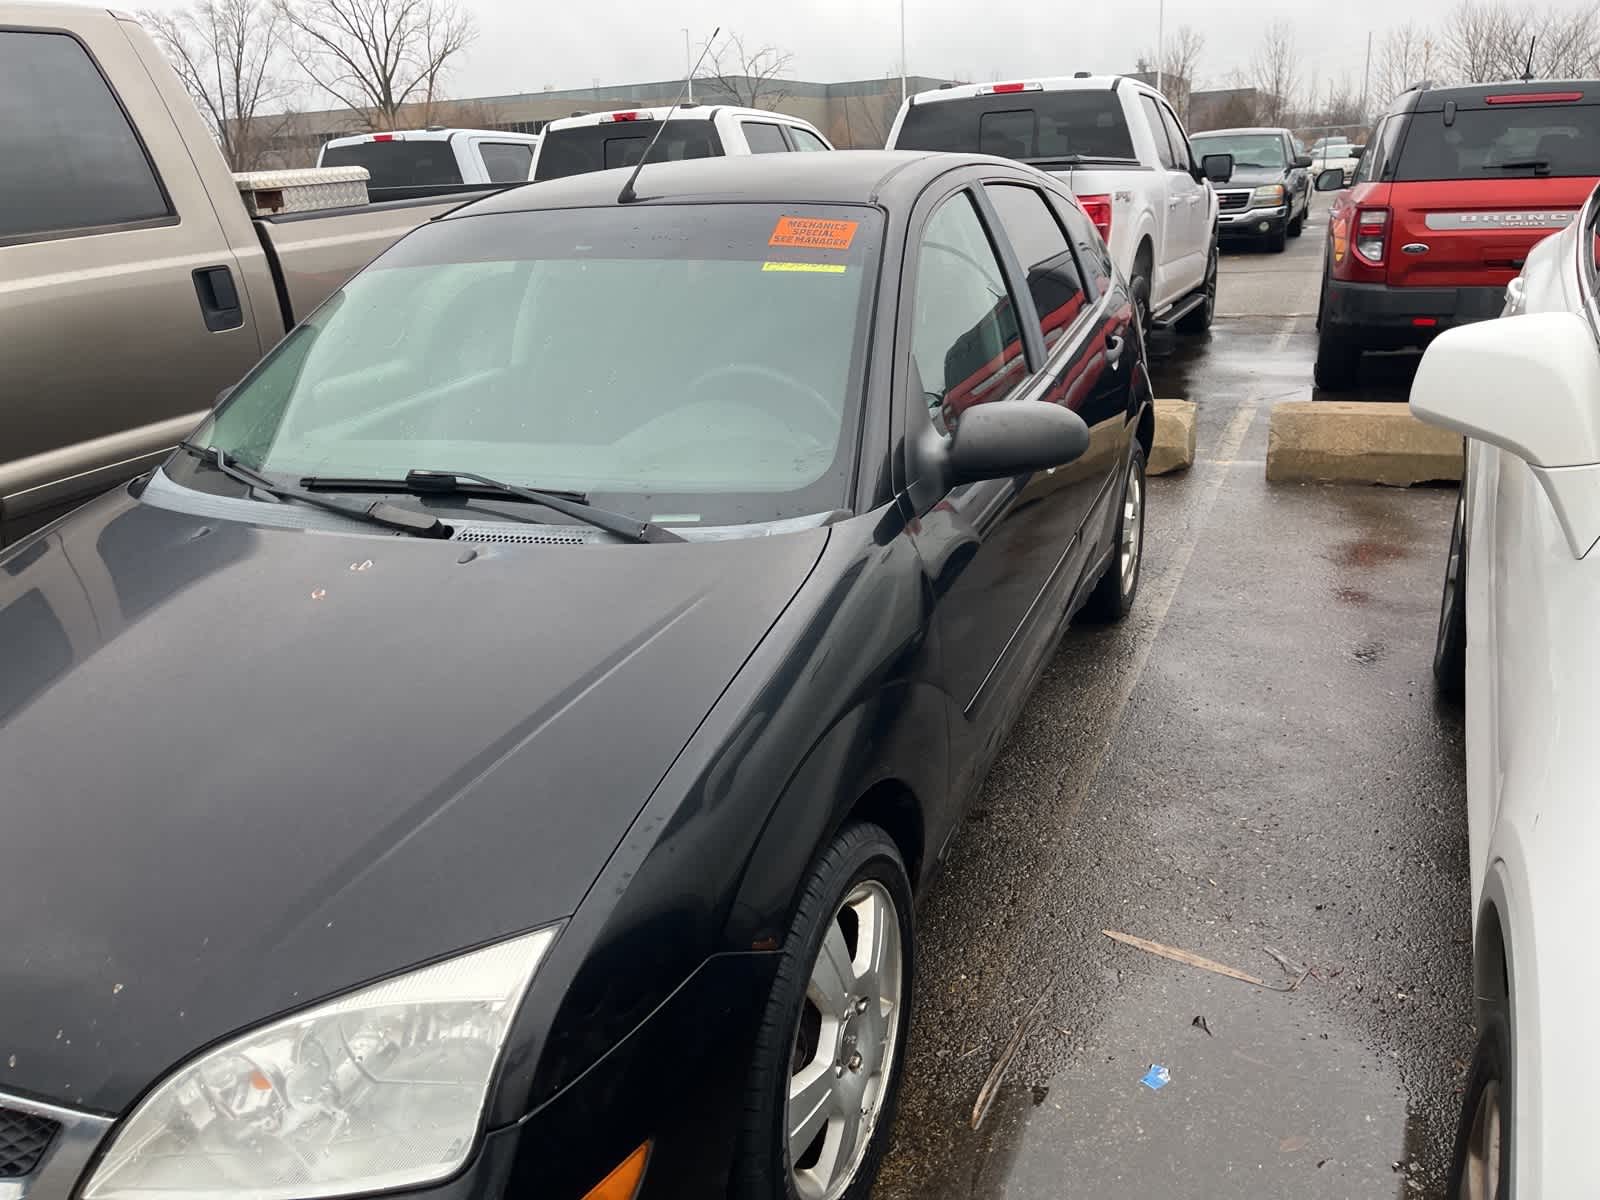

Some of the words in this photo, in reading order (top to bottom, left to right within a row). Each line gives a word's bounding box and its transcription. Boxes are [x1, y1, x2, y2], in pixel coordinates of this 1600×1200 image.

[788, 221, 848, 231] MECHANICS
[792, 229, 834, 238] SPECIAL
[774, 235, 794, 243] SEE
[795, 236, 848, 245] MANAGER
